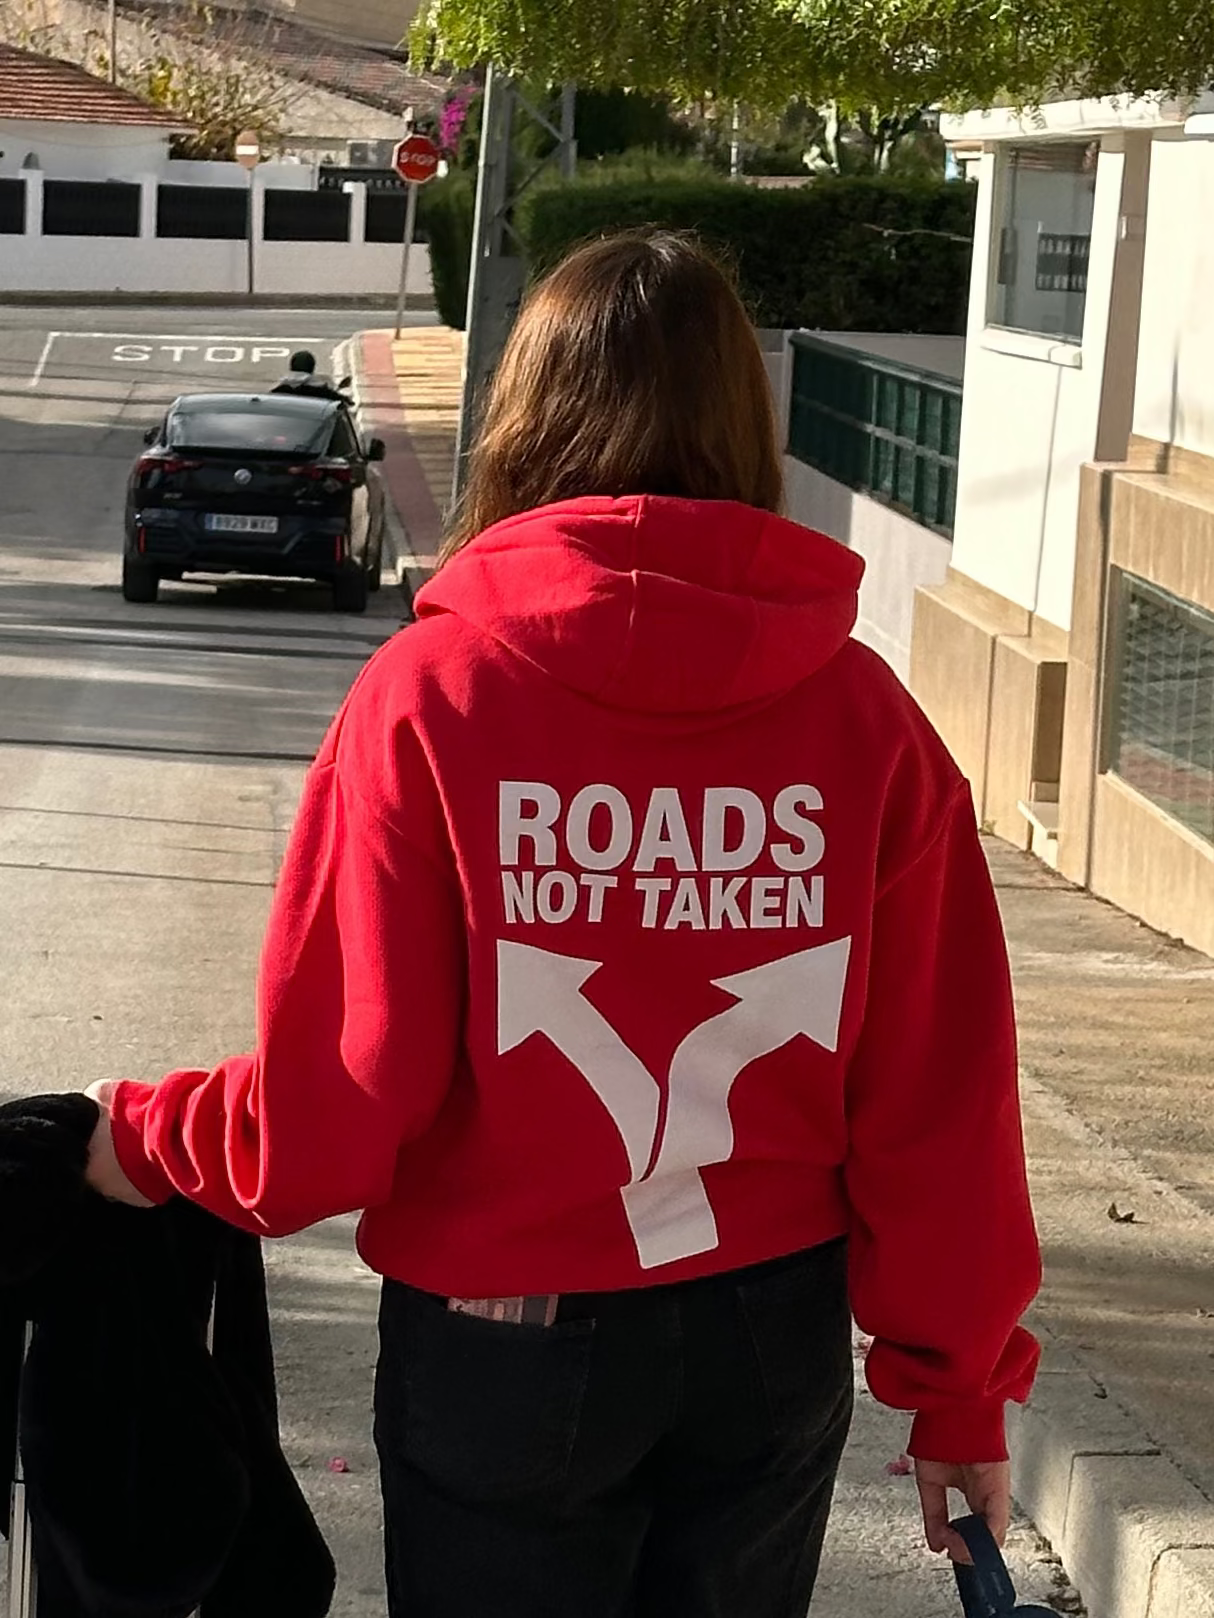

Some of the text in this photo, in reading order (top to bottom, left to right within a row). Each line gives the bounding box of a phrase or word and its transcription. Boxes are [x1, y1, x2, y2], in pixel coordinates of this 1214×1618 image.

[400, 151, 436, 166] STOP
[111, 344, 290, 363] STOP
[499, 780, 826, 872] ROADS
[501, 870, 825, 930] NOT TAKEN
